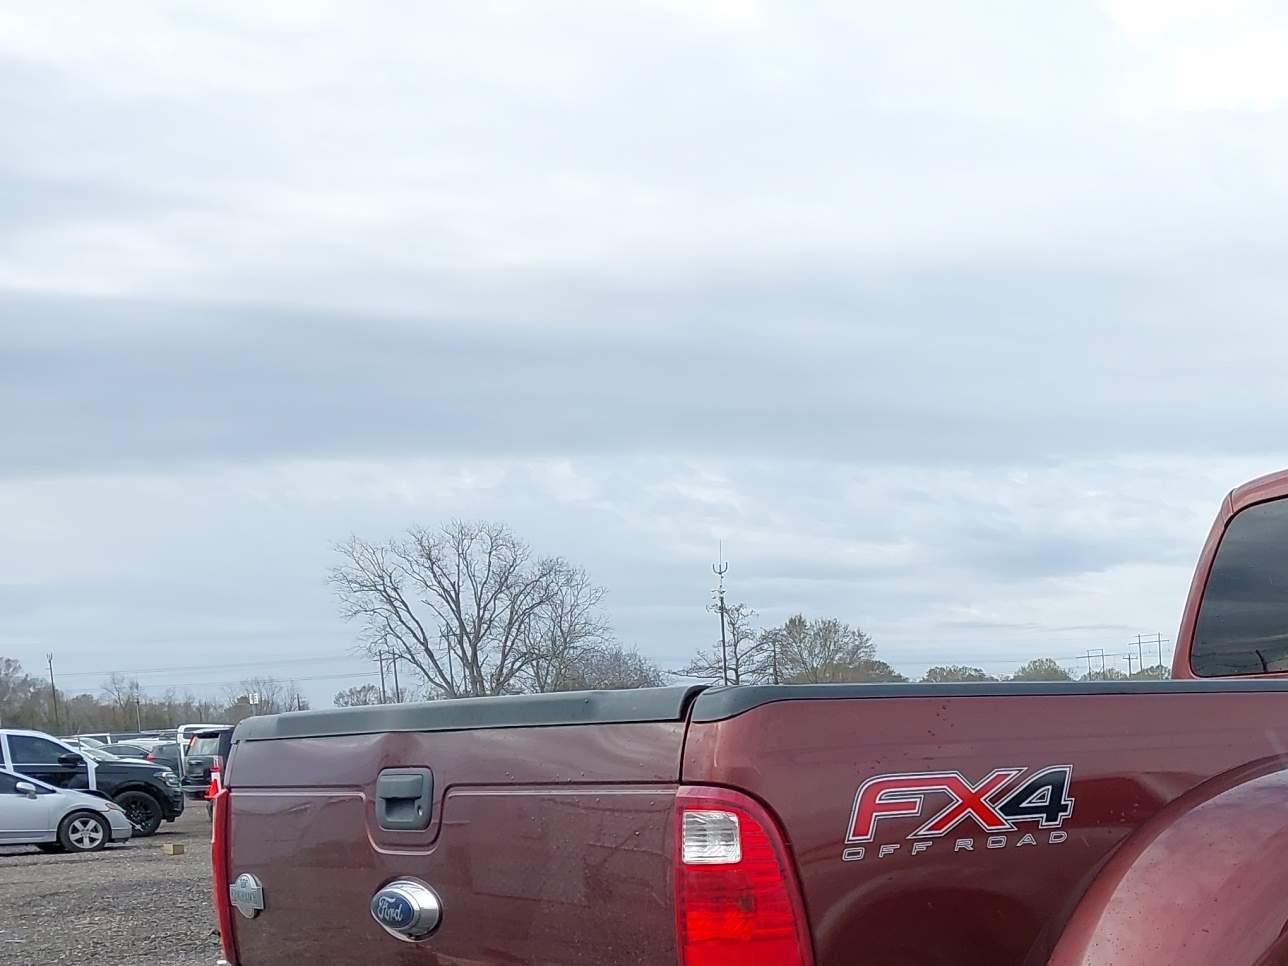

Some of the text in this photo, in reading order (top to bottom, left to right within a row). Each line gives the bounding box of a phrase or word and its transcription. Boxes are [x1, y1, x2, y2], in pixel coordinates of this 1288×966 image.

[845, 765, 1075, 844] FX4
[841, 831, 1069, 862] OFF ROAD
[377, 896, 404, 922] Ford
